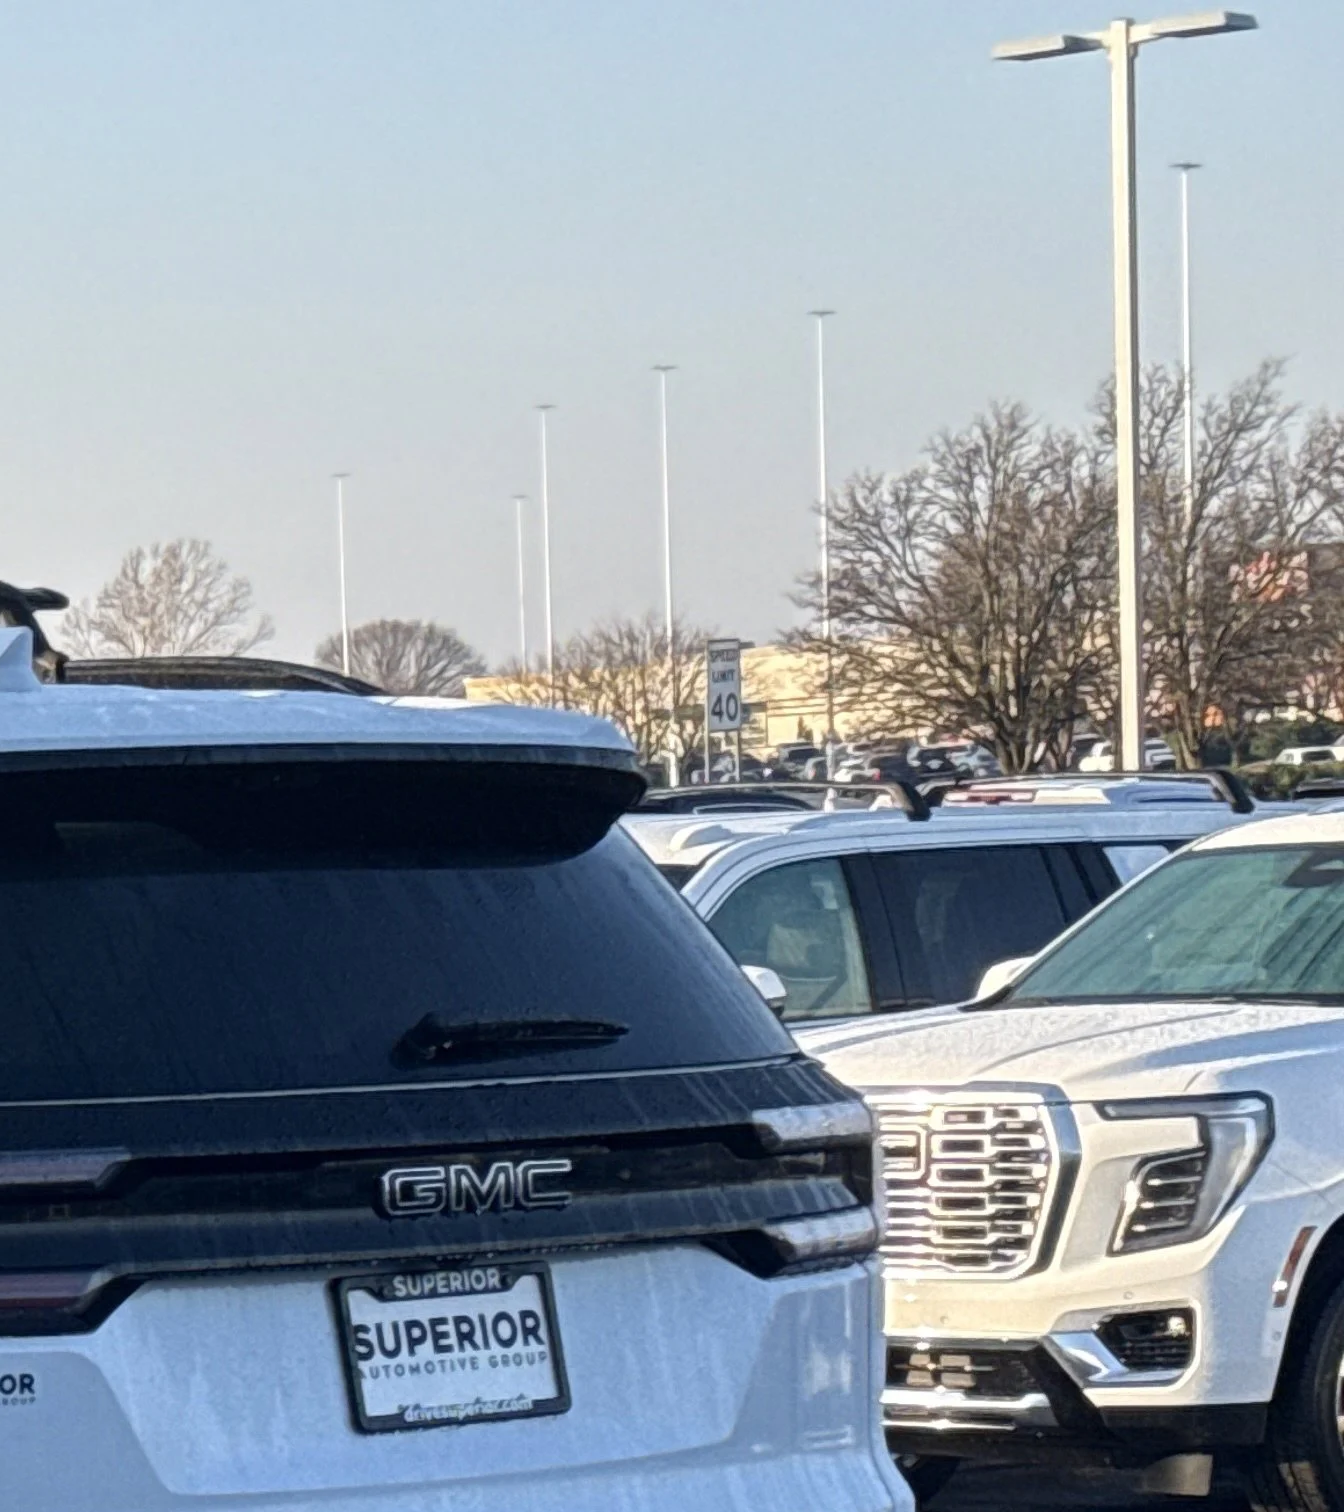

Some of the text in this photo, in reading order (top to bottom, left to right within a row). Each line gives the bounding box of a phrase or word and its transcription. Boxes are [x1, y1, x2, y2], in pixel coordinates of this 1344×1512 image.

[710, 692, 739, 723] 40
[378, 1158, 573, 1217] GMC
[392, 1267, 502, 1298] SUPERIOR
[353, 1309, 546, 1362] SUPERIOR
